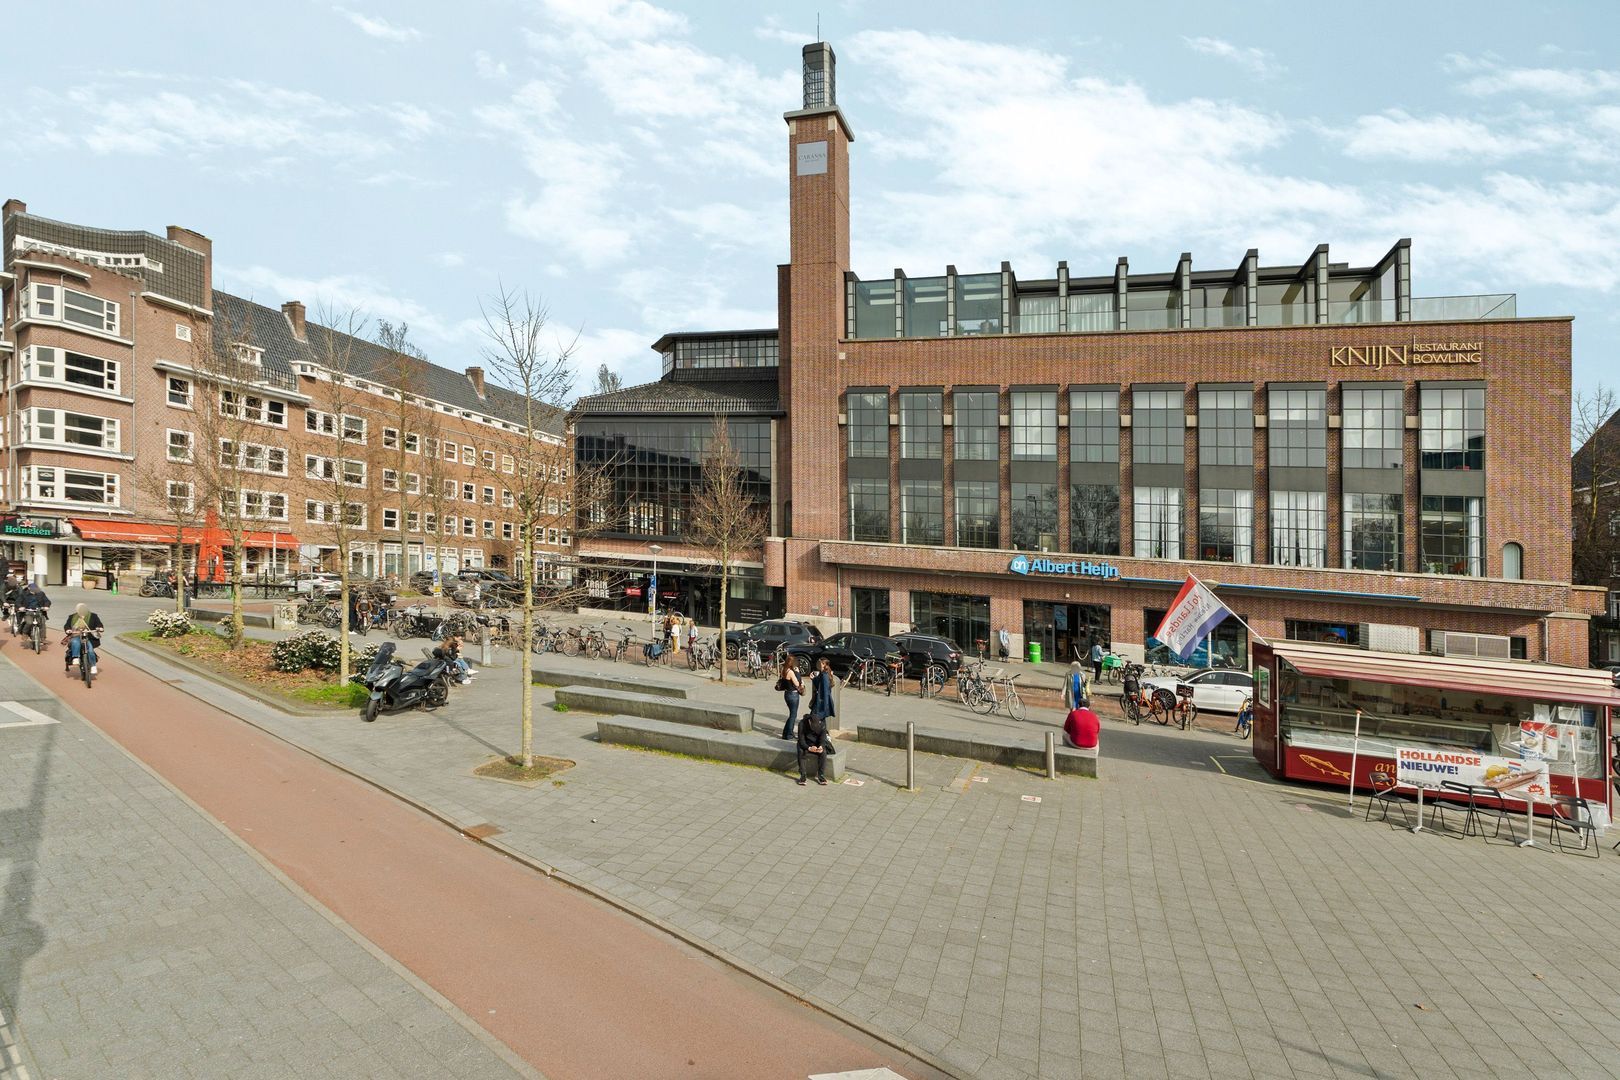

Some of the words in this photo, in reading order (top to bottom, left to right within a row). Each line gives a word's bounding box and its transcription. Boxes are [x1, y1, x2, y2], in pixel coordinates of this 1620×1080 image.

[1413, 342, 1482, 352] RESTAURANT
[1331, 345, 1407, 370] KNIJN
[1413, 352, 1482, 364] BOWLING
[5, 525, 51, 536] Heineken
[1031, 559, 1077, 574] Albert
[1080, 561, 1120, 579] Heijn
[585, 580, 608, 589] TRAIN
[588, 588, 610, 598] MORE
[1400, 750, 1481, 767] HOLLANDSE
[1400, 761, 1459, 775] NIEUWE!
